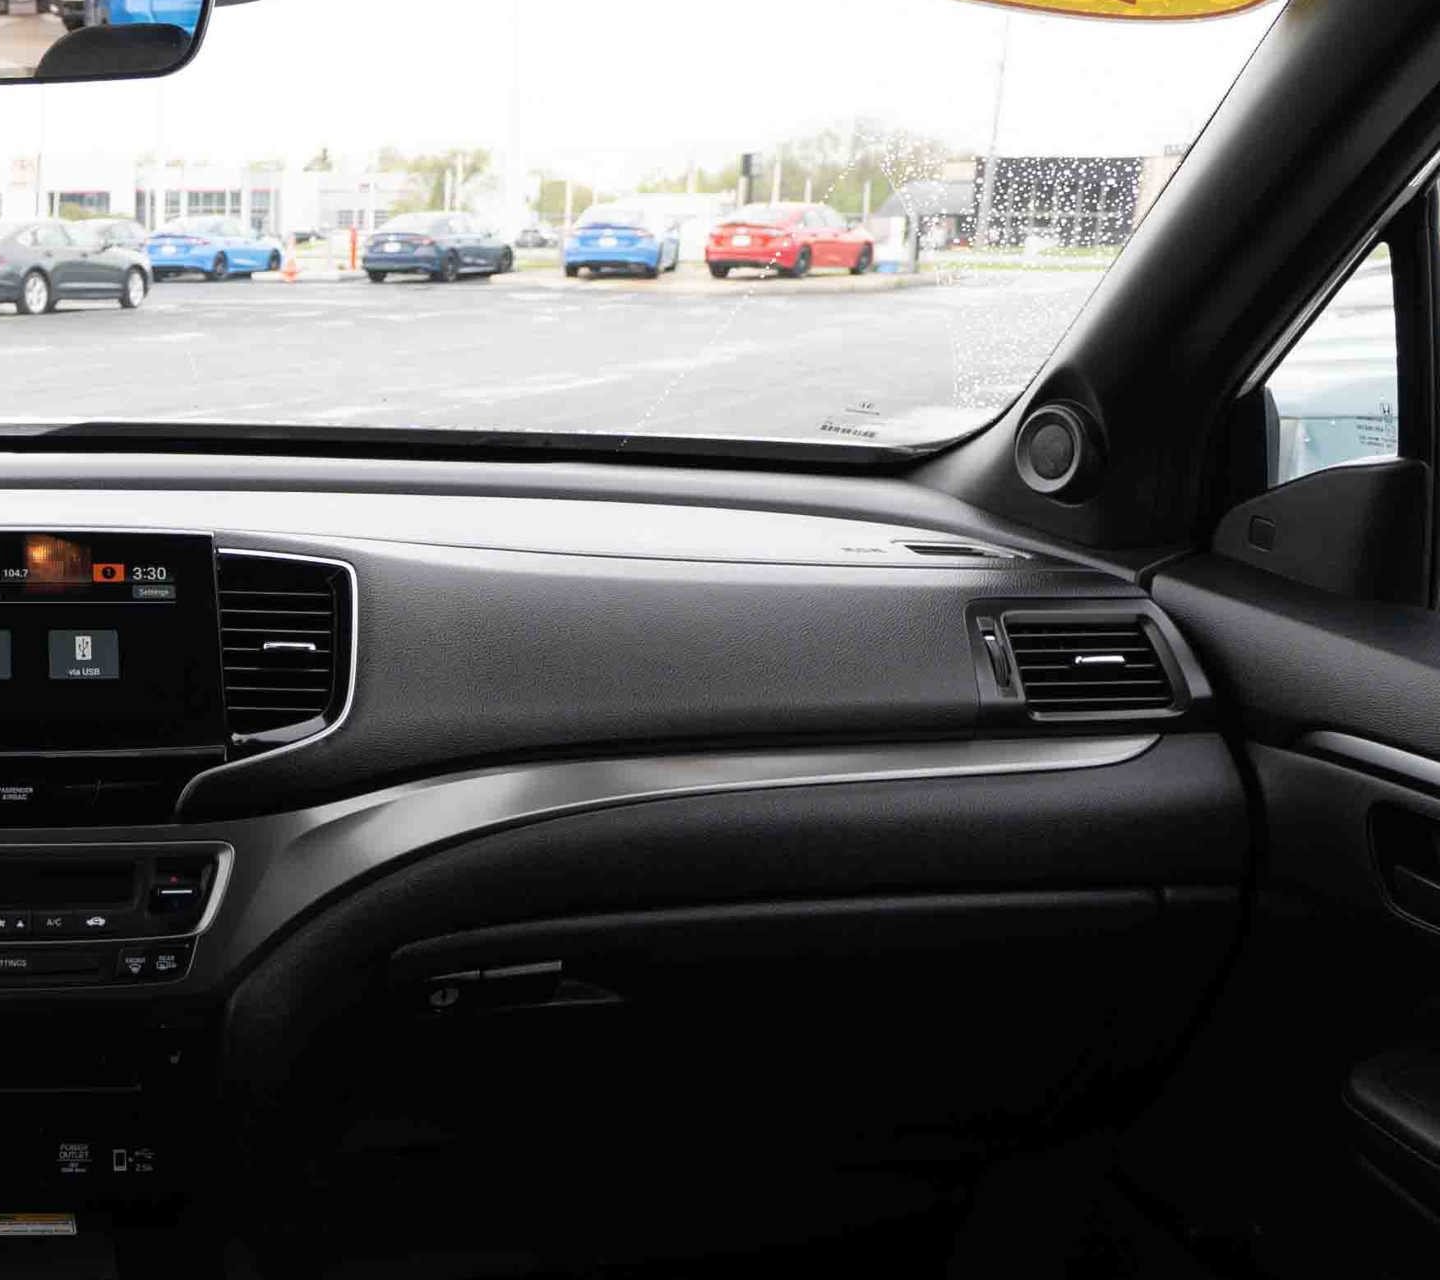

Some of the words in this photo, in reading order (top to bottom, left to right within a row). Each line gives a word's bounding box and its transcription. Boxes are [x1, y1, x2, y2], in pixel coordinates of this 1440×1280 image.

[3, 569, 28, 578] 104.7
[132, 567, 167, 580] 3:30
[68, 668, 80, 676] via
[82, 668, 100, 676] USB
[47, 918, 63, 927] A/C
[59, 1151, 89, 1160] OUTLET
